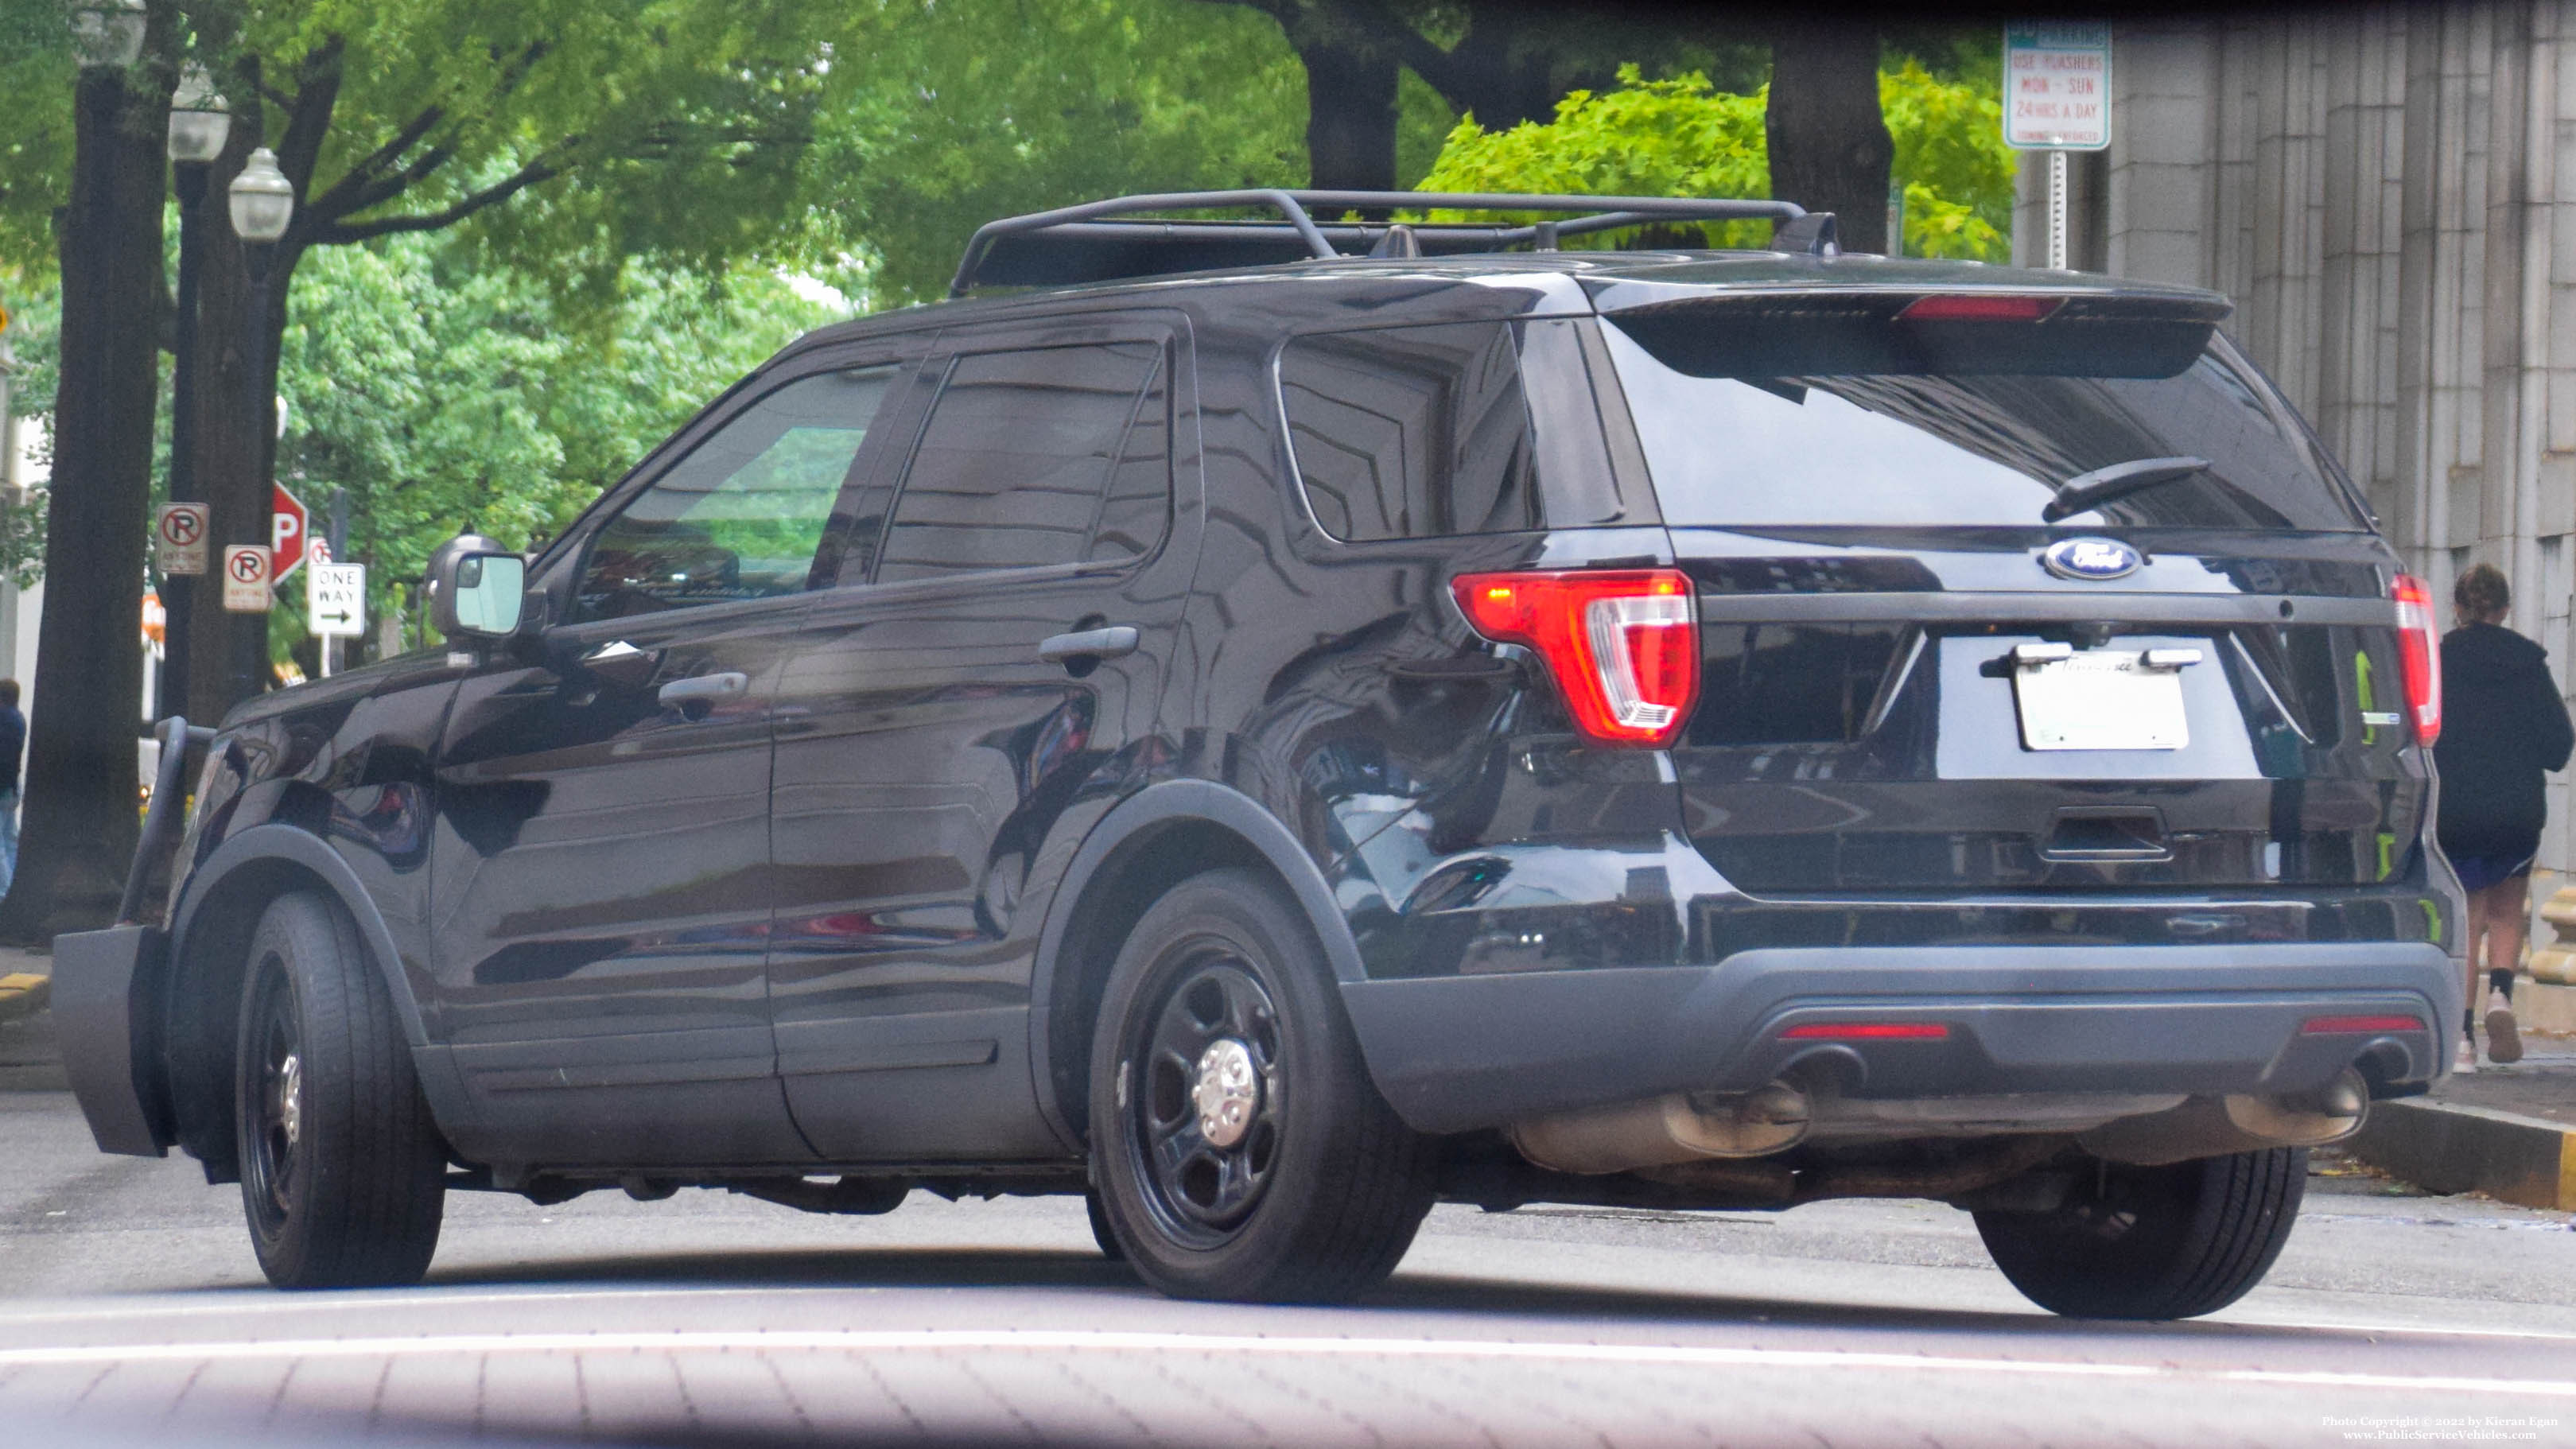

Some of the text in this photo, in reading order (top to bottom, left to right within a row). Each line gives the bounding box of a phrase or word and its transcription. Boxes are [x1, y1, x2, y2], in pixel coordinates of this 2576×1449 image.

[2013, 54, 2102, 71] USE FLASHERS
[2021, 76, 2050, 94] MON
[2069, 77, 2093, 95] SUN
[2063, 104, 2071, 118] A
[2076, 103, 2097, 118] DAY
[2073, 542, 2123, 569] Ford
[319, 571, 356, 585] ONE
[319, 590, 355, 603] WAY
